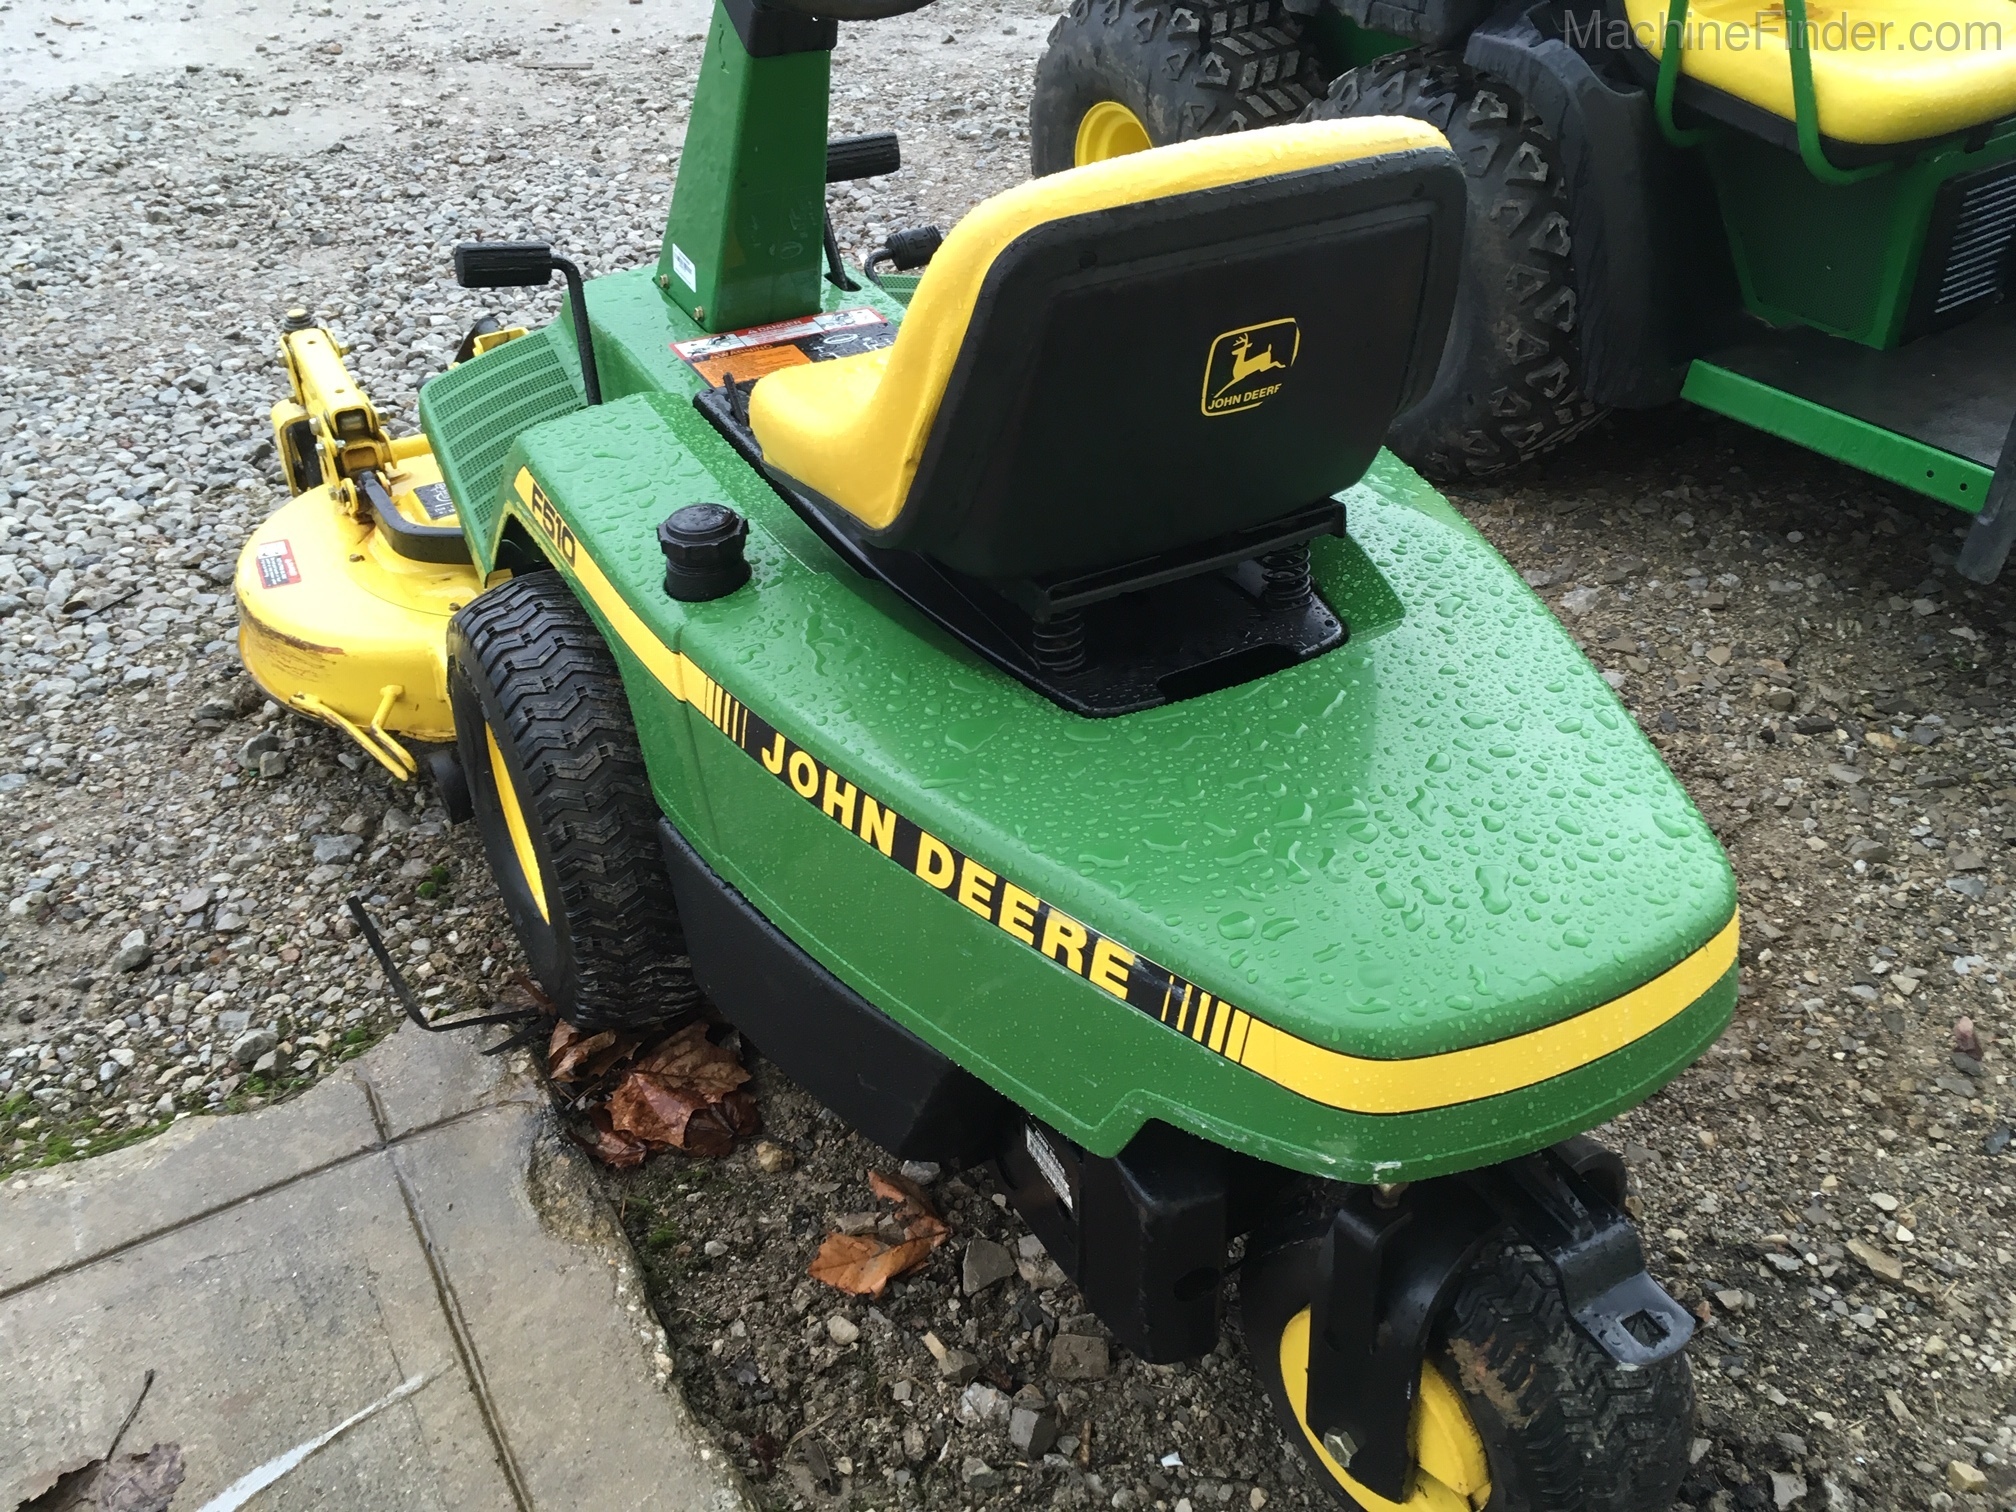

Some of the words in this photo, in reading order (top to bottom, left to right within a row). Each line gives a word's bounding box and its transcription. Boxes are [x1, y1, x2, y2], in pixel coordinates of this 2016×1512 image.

[1208, 394, 1241, 410] JOHN
[532, 483, 576, 568] F510
[762, 732, 897, 857] JOHN
[915, 831, 1136, 1001] DEERE
